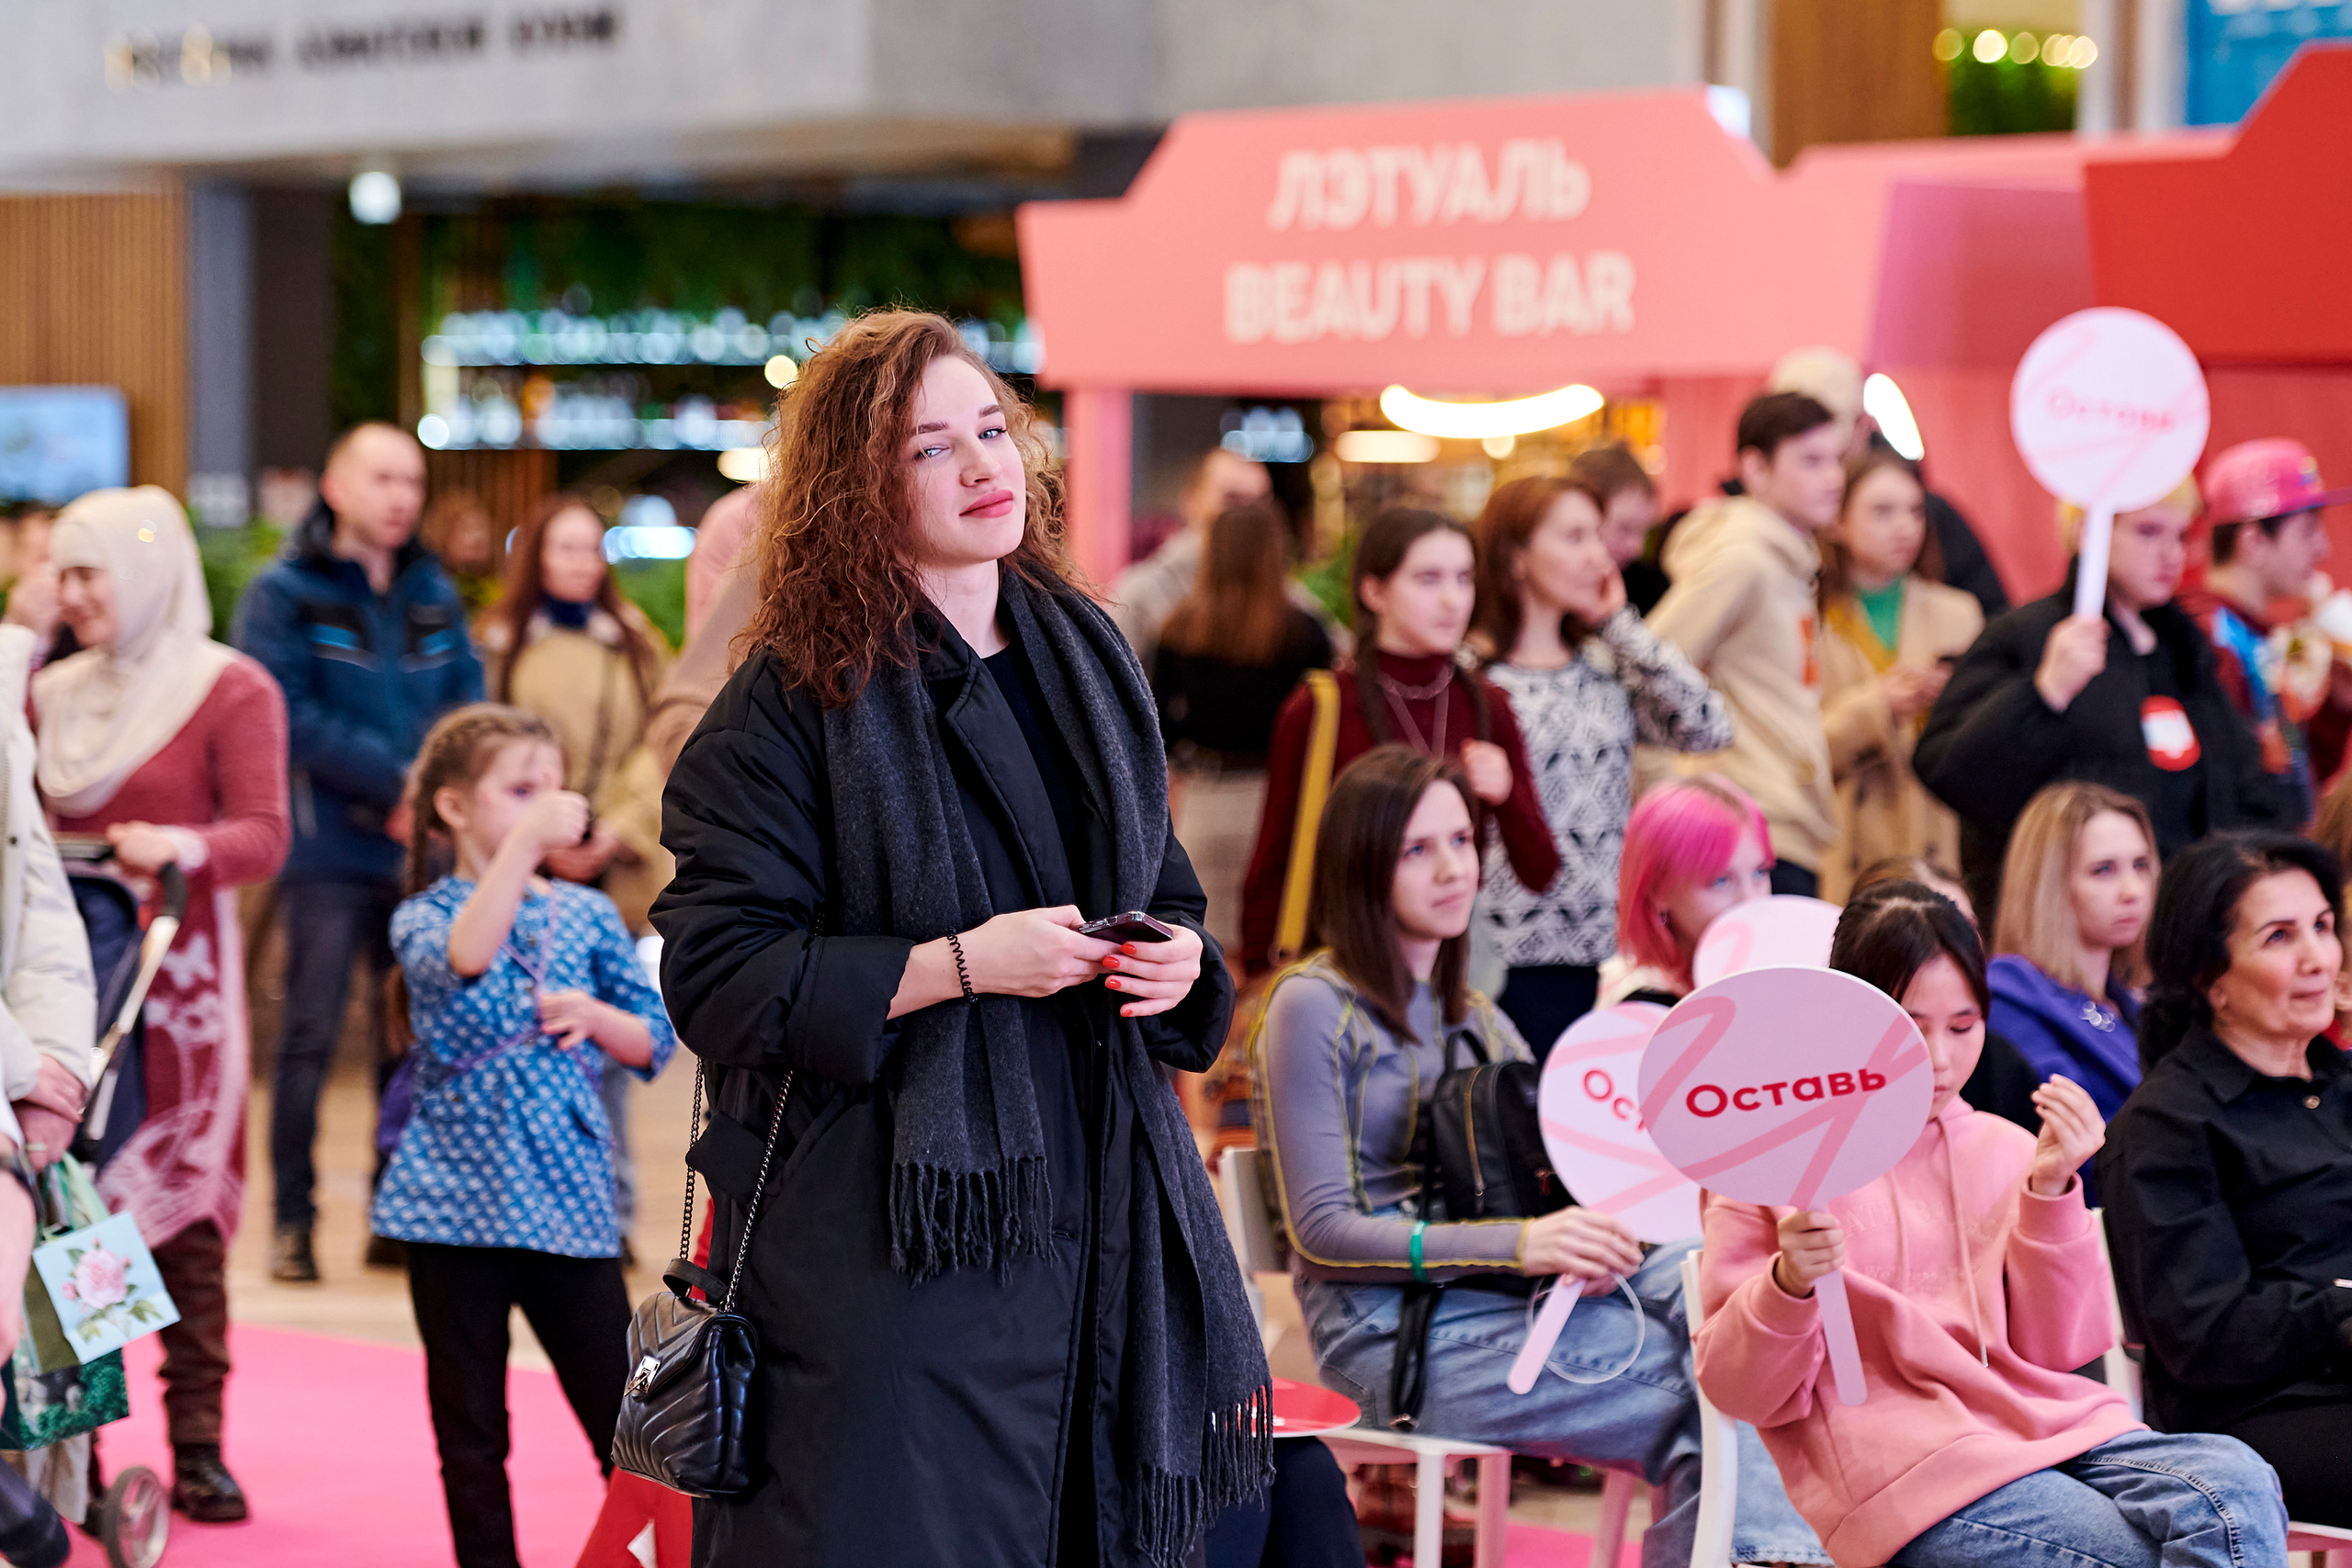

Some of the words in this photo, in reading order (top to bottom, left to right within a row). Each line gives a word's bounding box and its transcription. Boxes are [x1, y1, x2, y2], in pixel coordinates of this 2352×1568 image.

[1269, 139, 1590, 230] ЛЭТУАЛЬ
[1226, 255, 1485, 343] BEAUTY
[1495, 251, 1636, 337] BAR
[1686, 1068, 1886, 1118] Оставь
